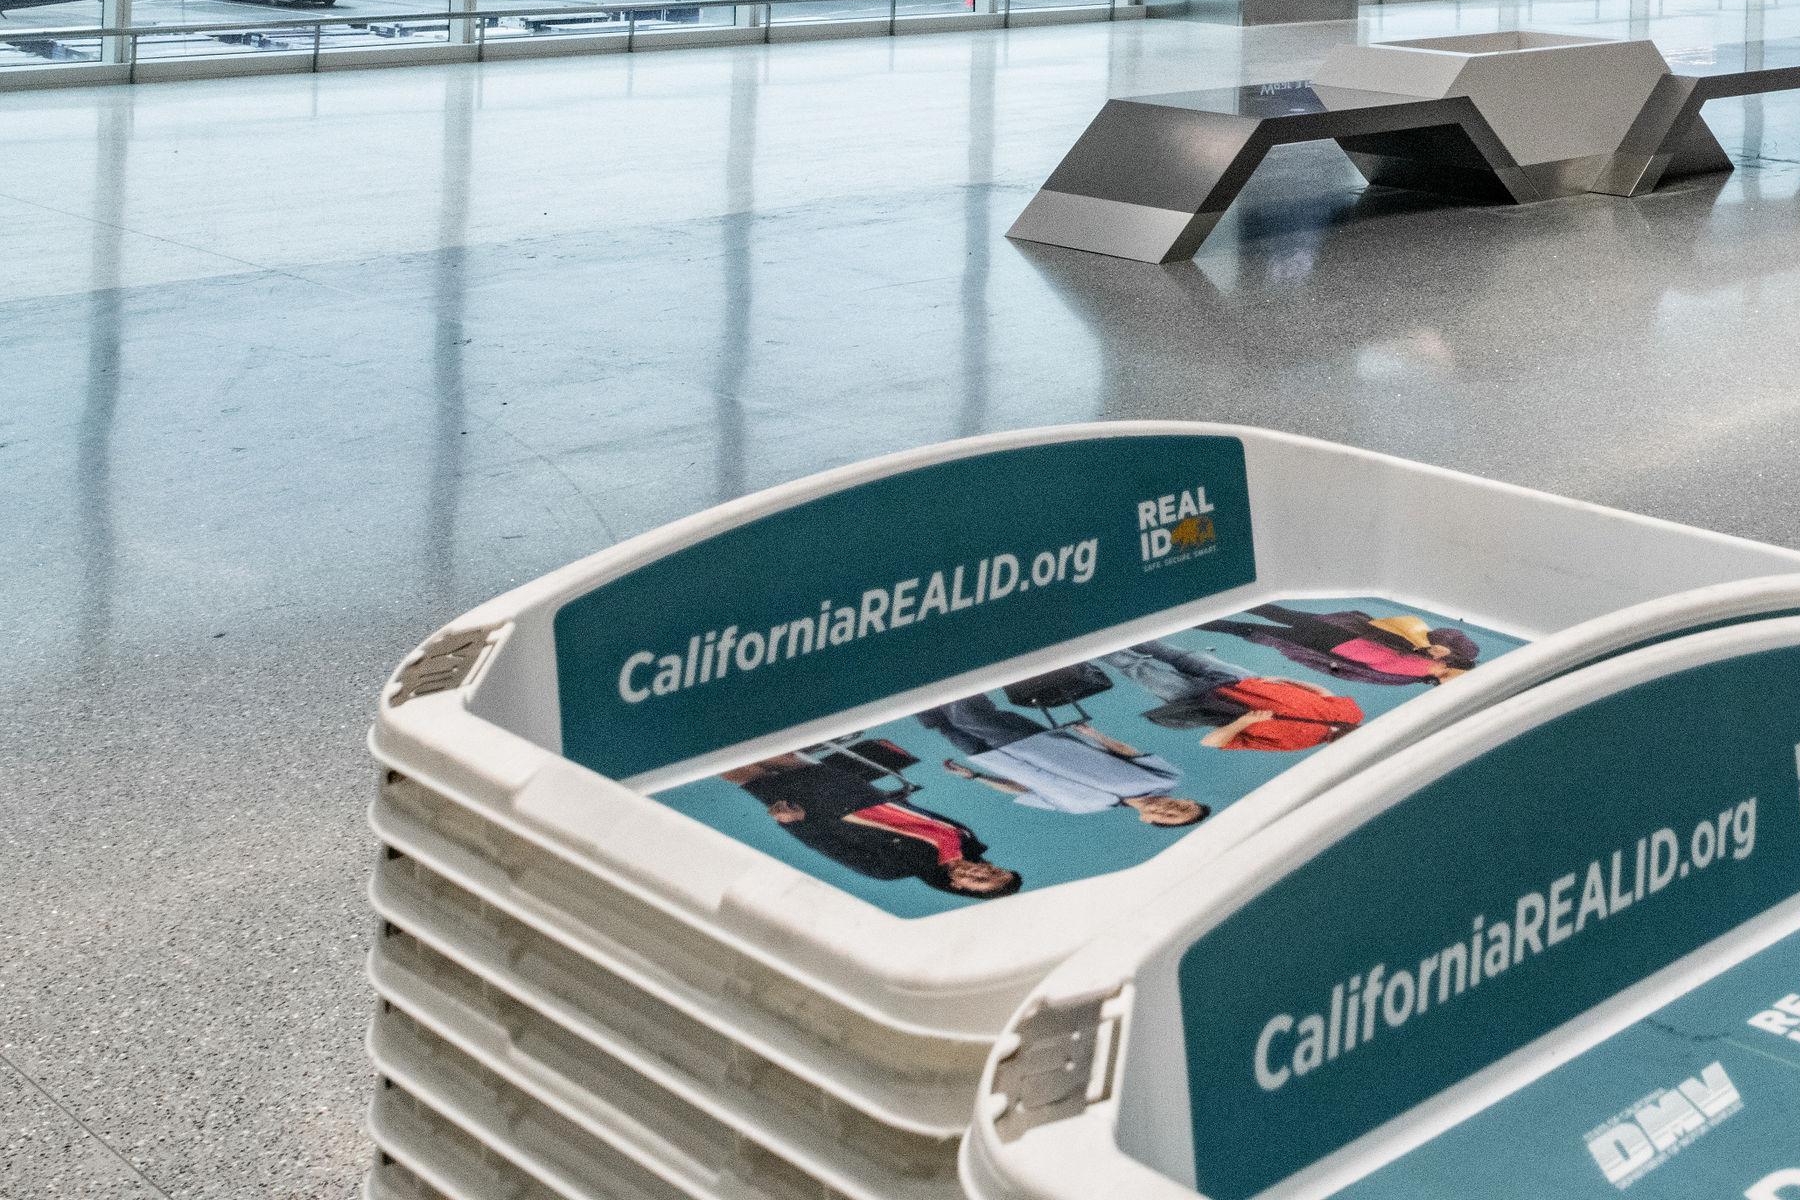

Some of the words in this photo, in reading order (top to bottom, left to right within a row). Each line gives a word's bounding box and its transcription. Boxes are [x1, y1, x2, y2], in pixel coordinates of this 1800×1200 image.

[1137, 486, 1215, 531] REAL
[1141, 528, 1172, 562] ID
[618, 536, 1099, 704] CaliforniaREALID.org
[1253, 796, 1757, 1093] CaliforniaREALID.org
[1588, 1060, 1742, 1184] DMV
